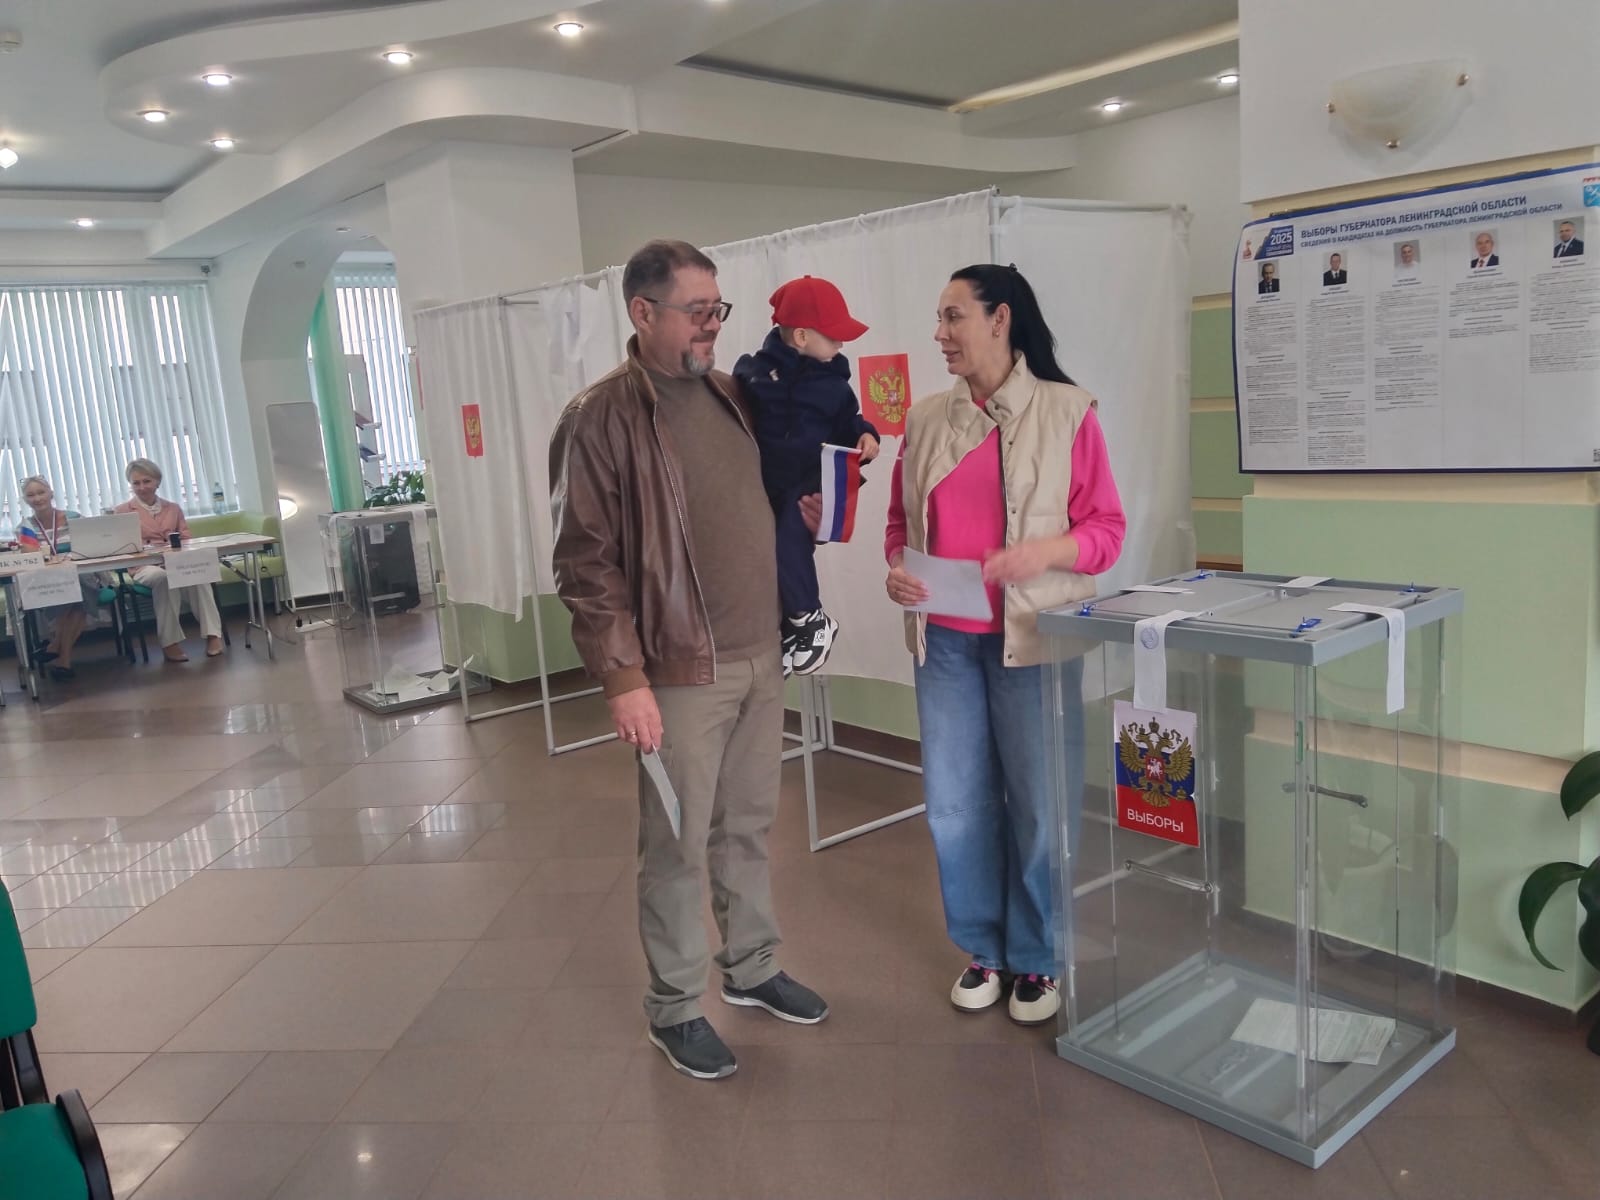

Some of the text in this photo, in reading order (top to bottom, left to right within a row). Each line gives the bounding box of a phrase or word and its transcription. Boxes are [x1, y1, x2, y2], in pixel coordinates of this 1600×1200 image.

[1300, 238, 1331, 248] СВЕДЕНИЯ
[1338, 231, 1374, 242] КАНДИДАТАХ
[1385, 224, 1423, 236] ДОЛЖНОСТЬ
[1424, 218, 1467, 230] ГУБЕРНАТОРА
[1469, 207, 1528, 223] ЛЕНИНГРАДСКОЙ
[1529, 203, 1563, 215] ОБЛАСТИ
[1301, 195, 1527, 239] ВЫБОРЫ ГУБЕРНАТОРА ЛЕНИНГРАДСКОЙ ОБЛАСТИ
[1271, 232, 1293, 246] 2025
[1127, 808, 1184, 833] ВЫБОРЫ
